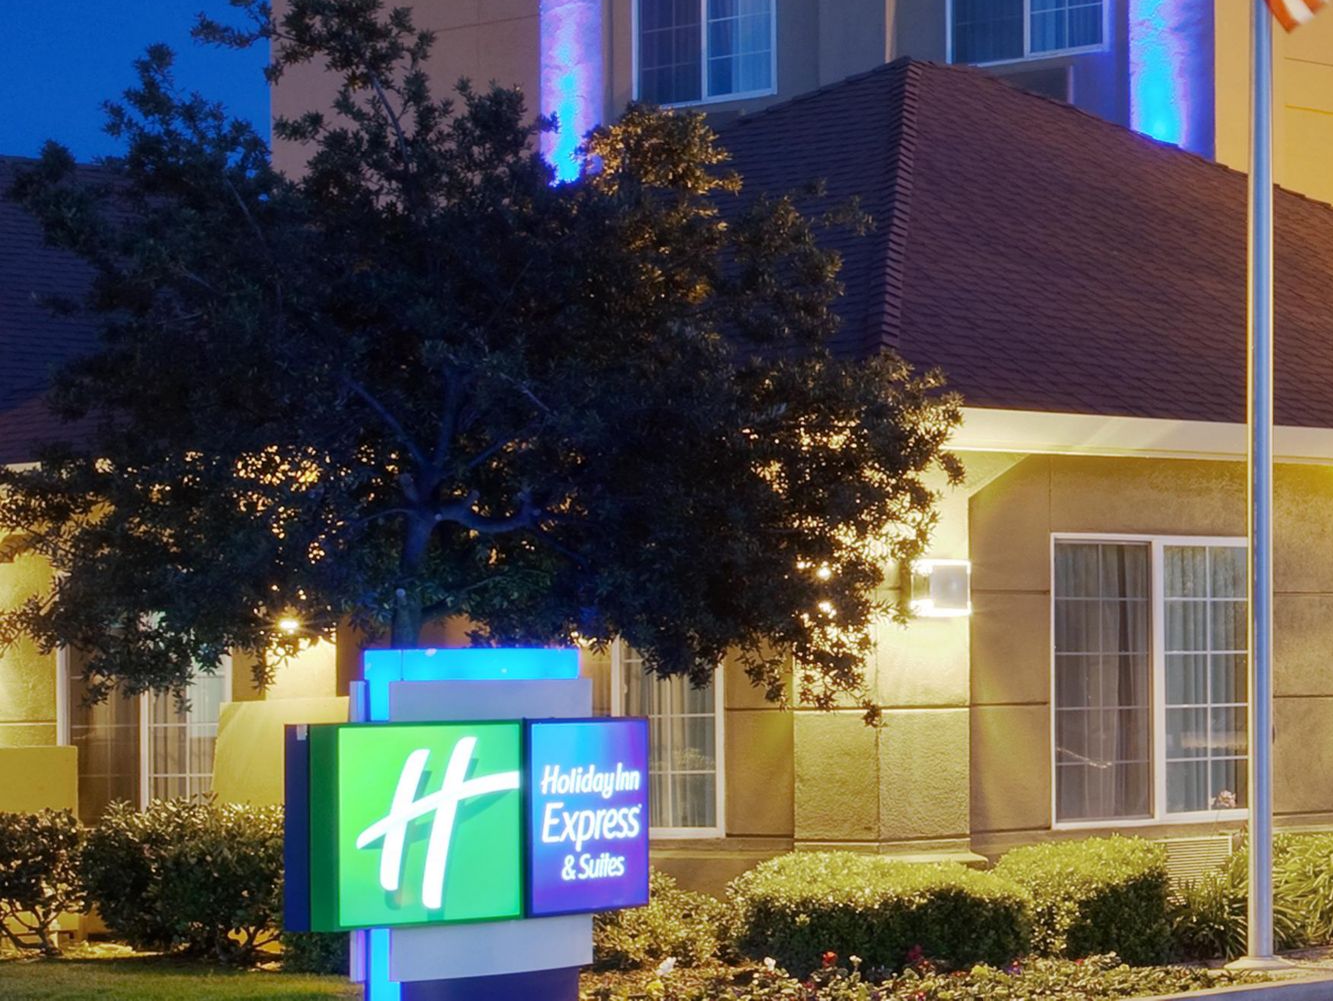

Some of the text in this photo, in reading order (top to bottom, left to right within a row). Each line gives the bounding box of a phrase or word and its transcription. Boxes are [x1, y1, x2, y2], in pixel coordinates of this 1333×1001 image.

[541, 762, 640, 799] Holiday Inn
[542, 802, 641, 852] Express
[561, 852, 625, 881] & Suites
